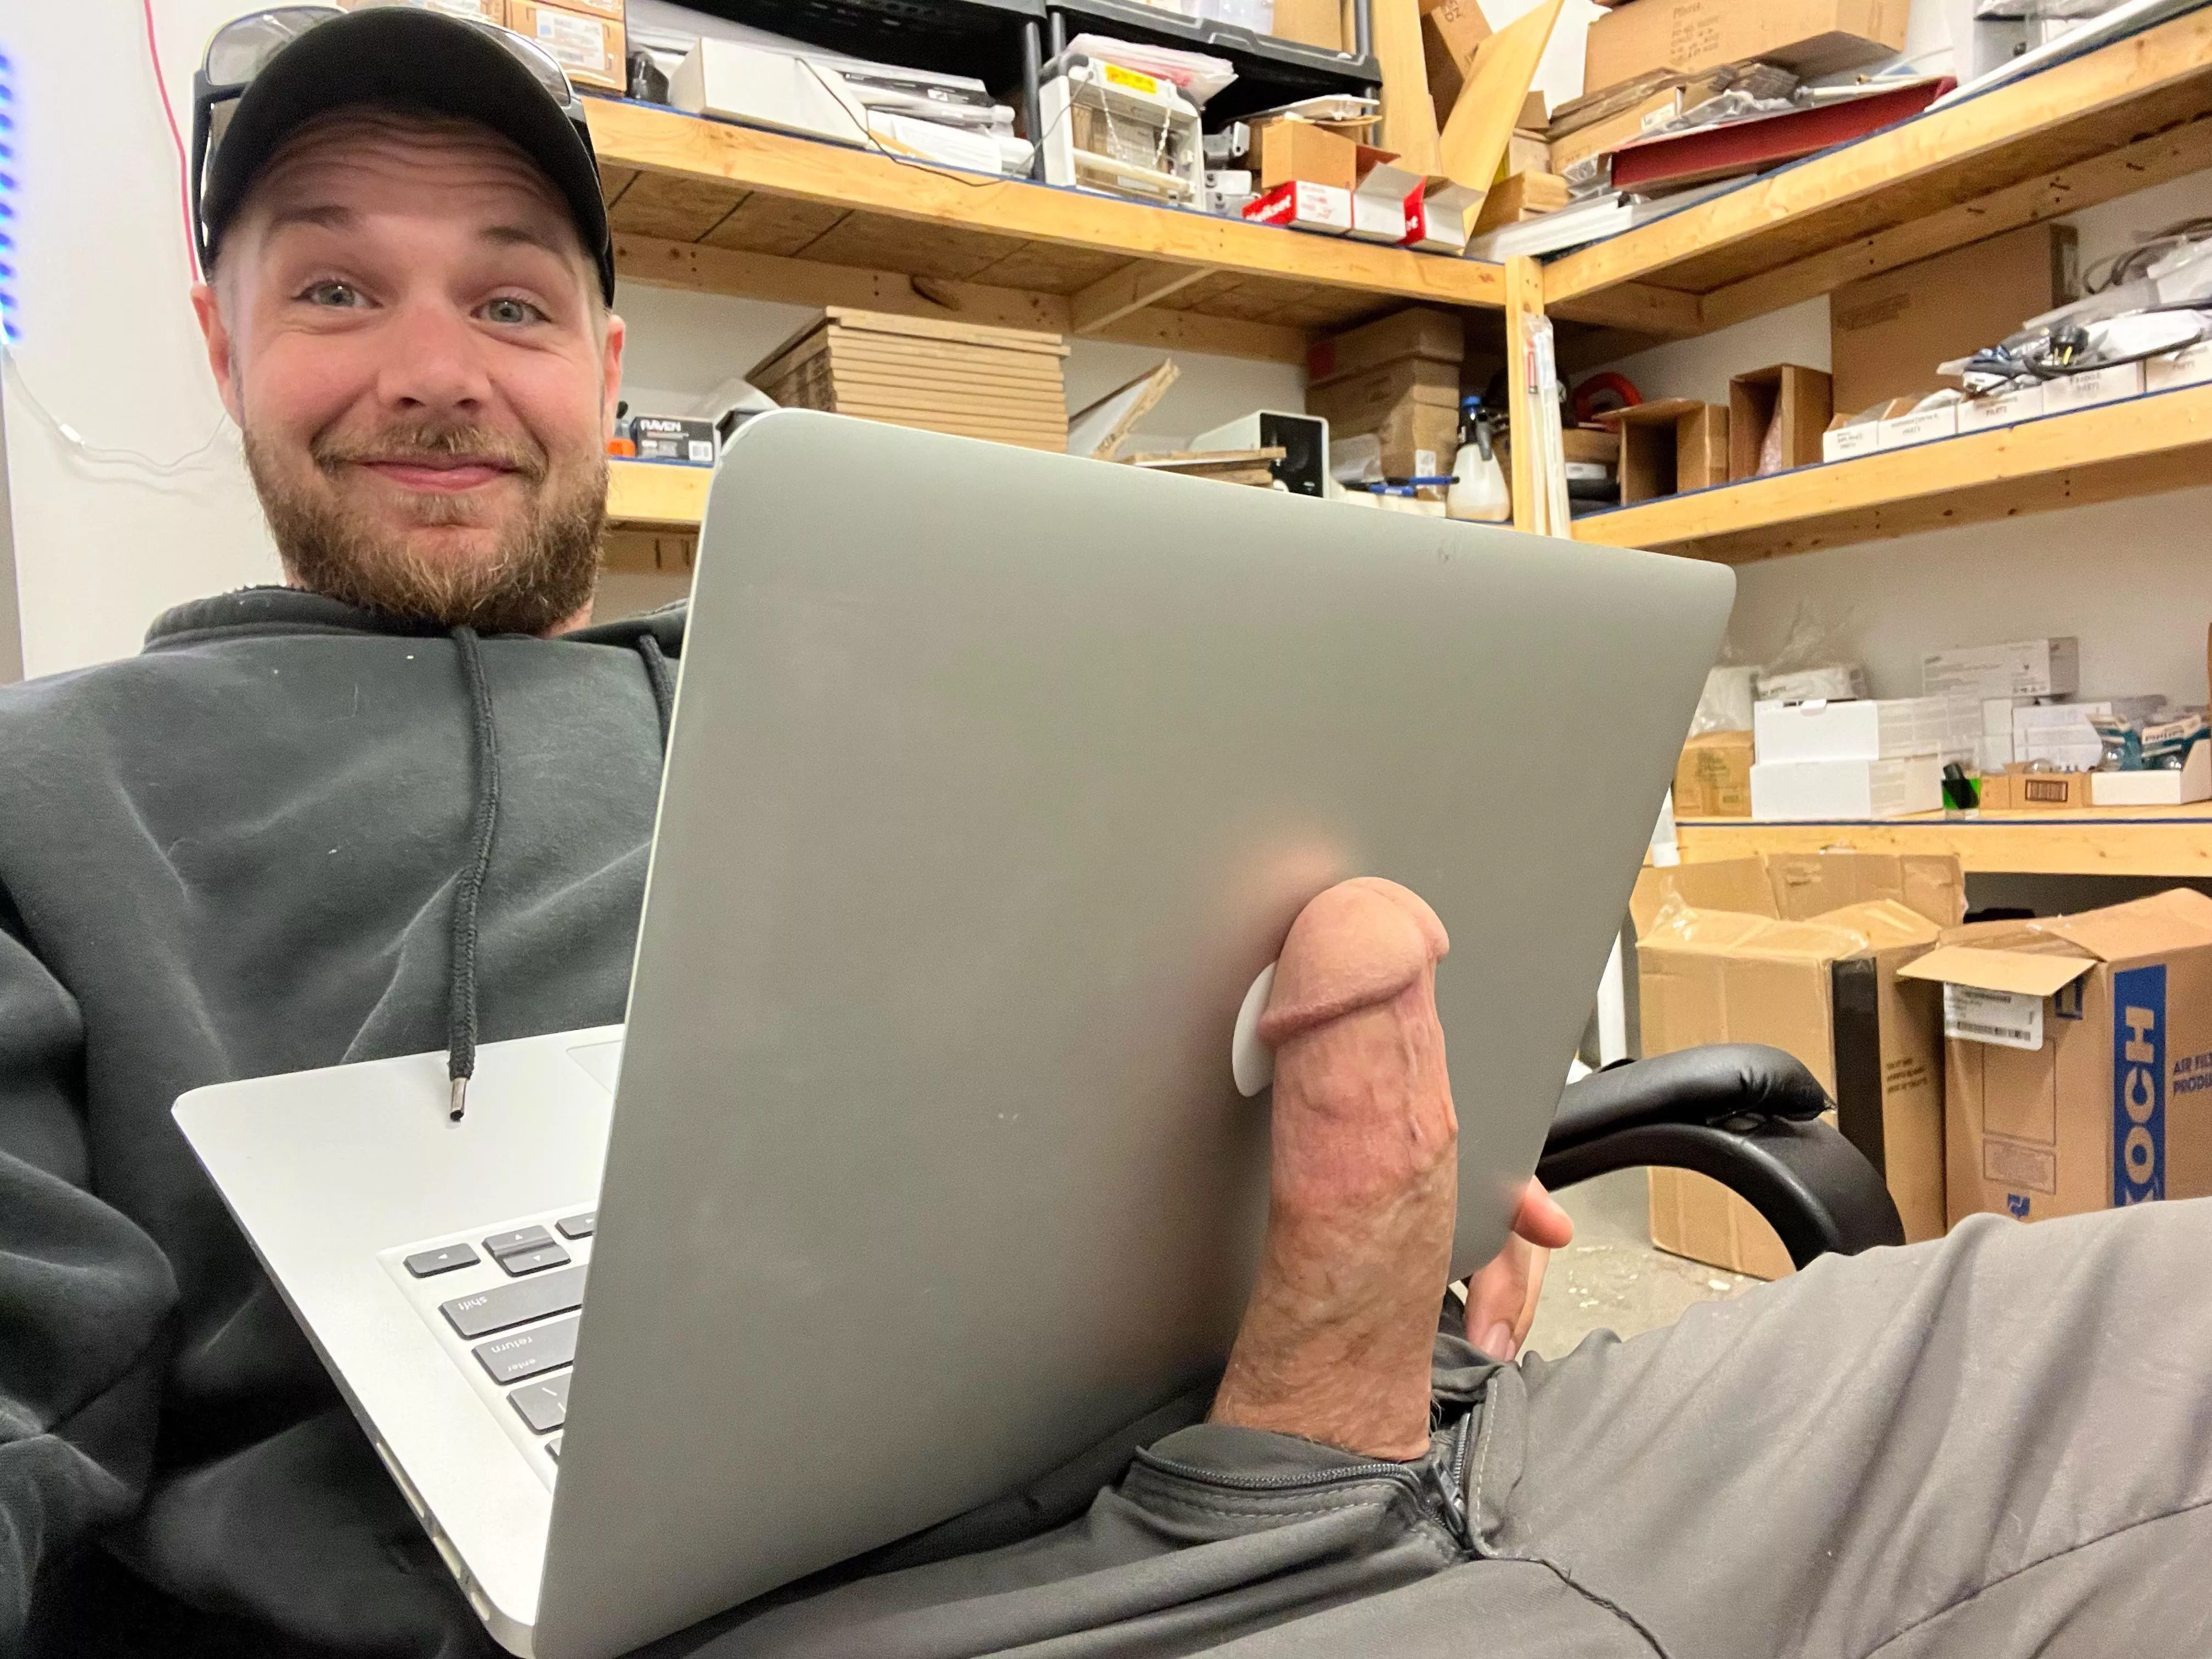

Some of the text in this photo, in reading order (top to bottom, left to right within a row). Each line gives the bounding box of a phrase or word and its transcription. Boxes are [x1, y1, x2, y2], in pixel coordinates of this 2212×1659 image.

[640, 419, 681, 432] RAVEN
[2174, 1057, 2192, 1075] AIR
[2125, 1006, 2155, 1205] OCH
[458, 1296, 488, 1311] shift
[490, 1336, 533, 1353] return
[508, 1358, 536, 1372] enter
